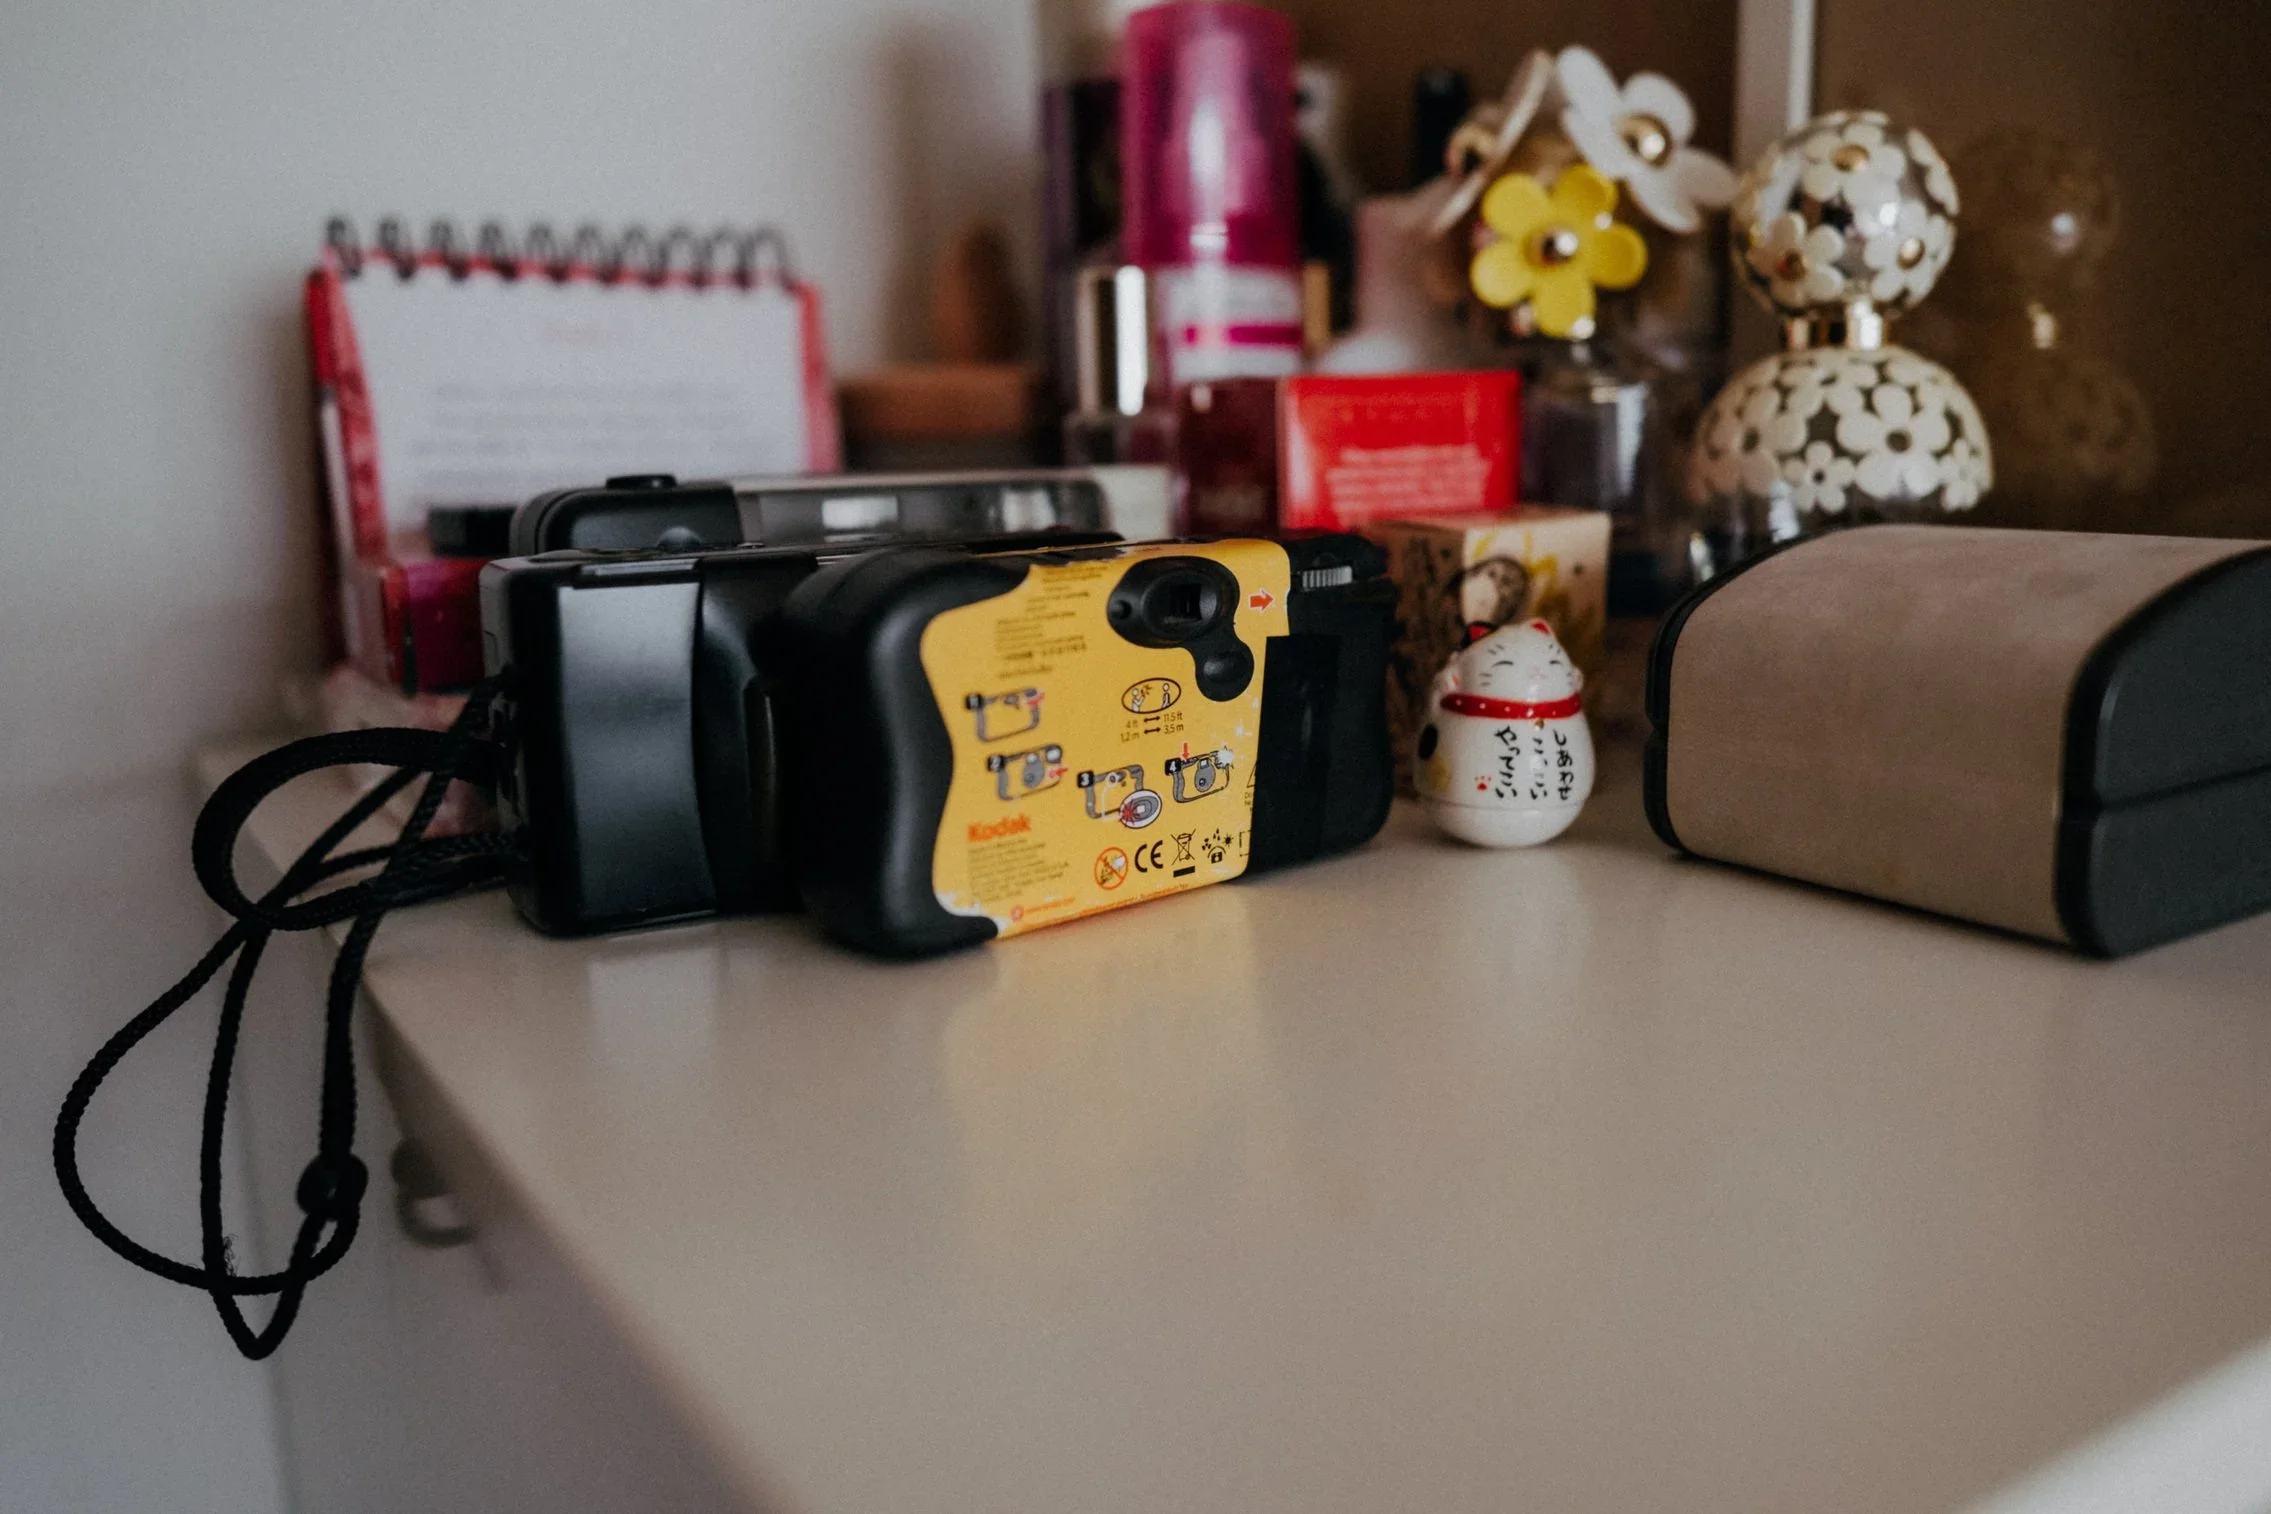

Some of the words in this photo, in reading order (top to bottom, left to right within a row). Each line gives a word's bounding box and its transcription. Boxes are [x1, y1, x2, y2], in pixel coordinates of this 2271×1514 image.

[1494, 724, 1520, 799] やってこい
[1553, 727, 1574, 800] しあわせ
[967, 814, 1031, 842] Kodak
[1134, 840, 1163, 873] CE
